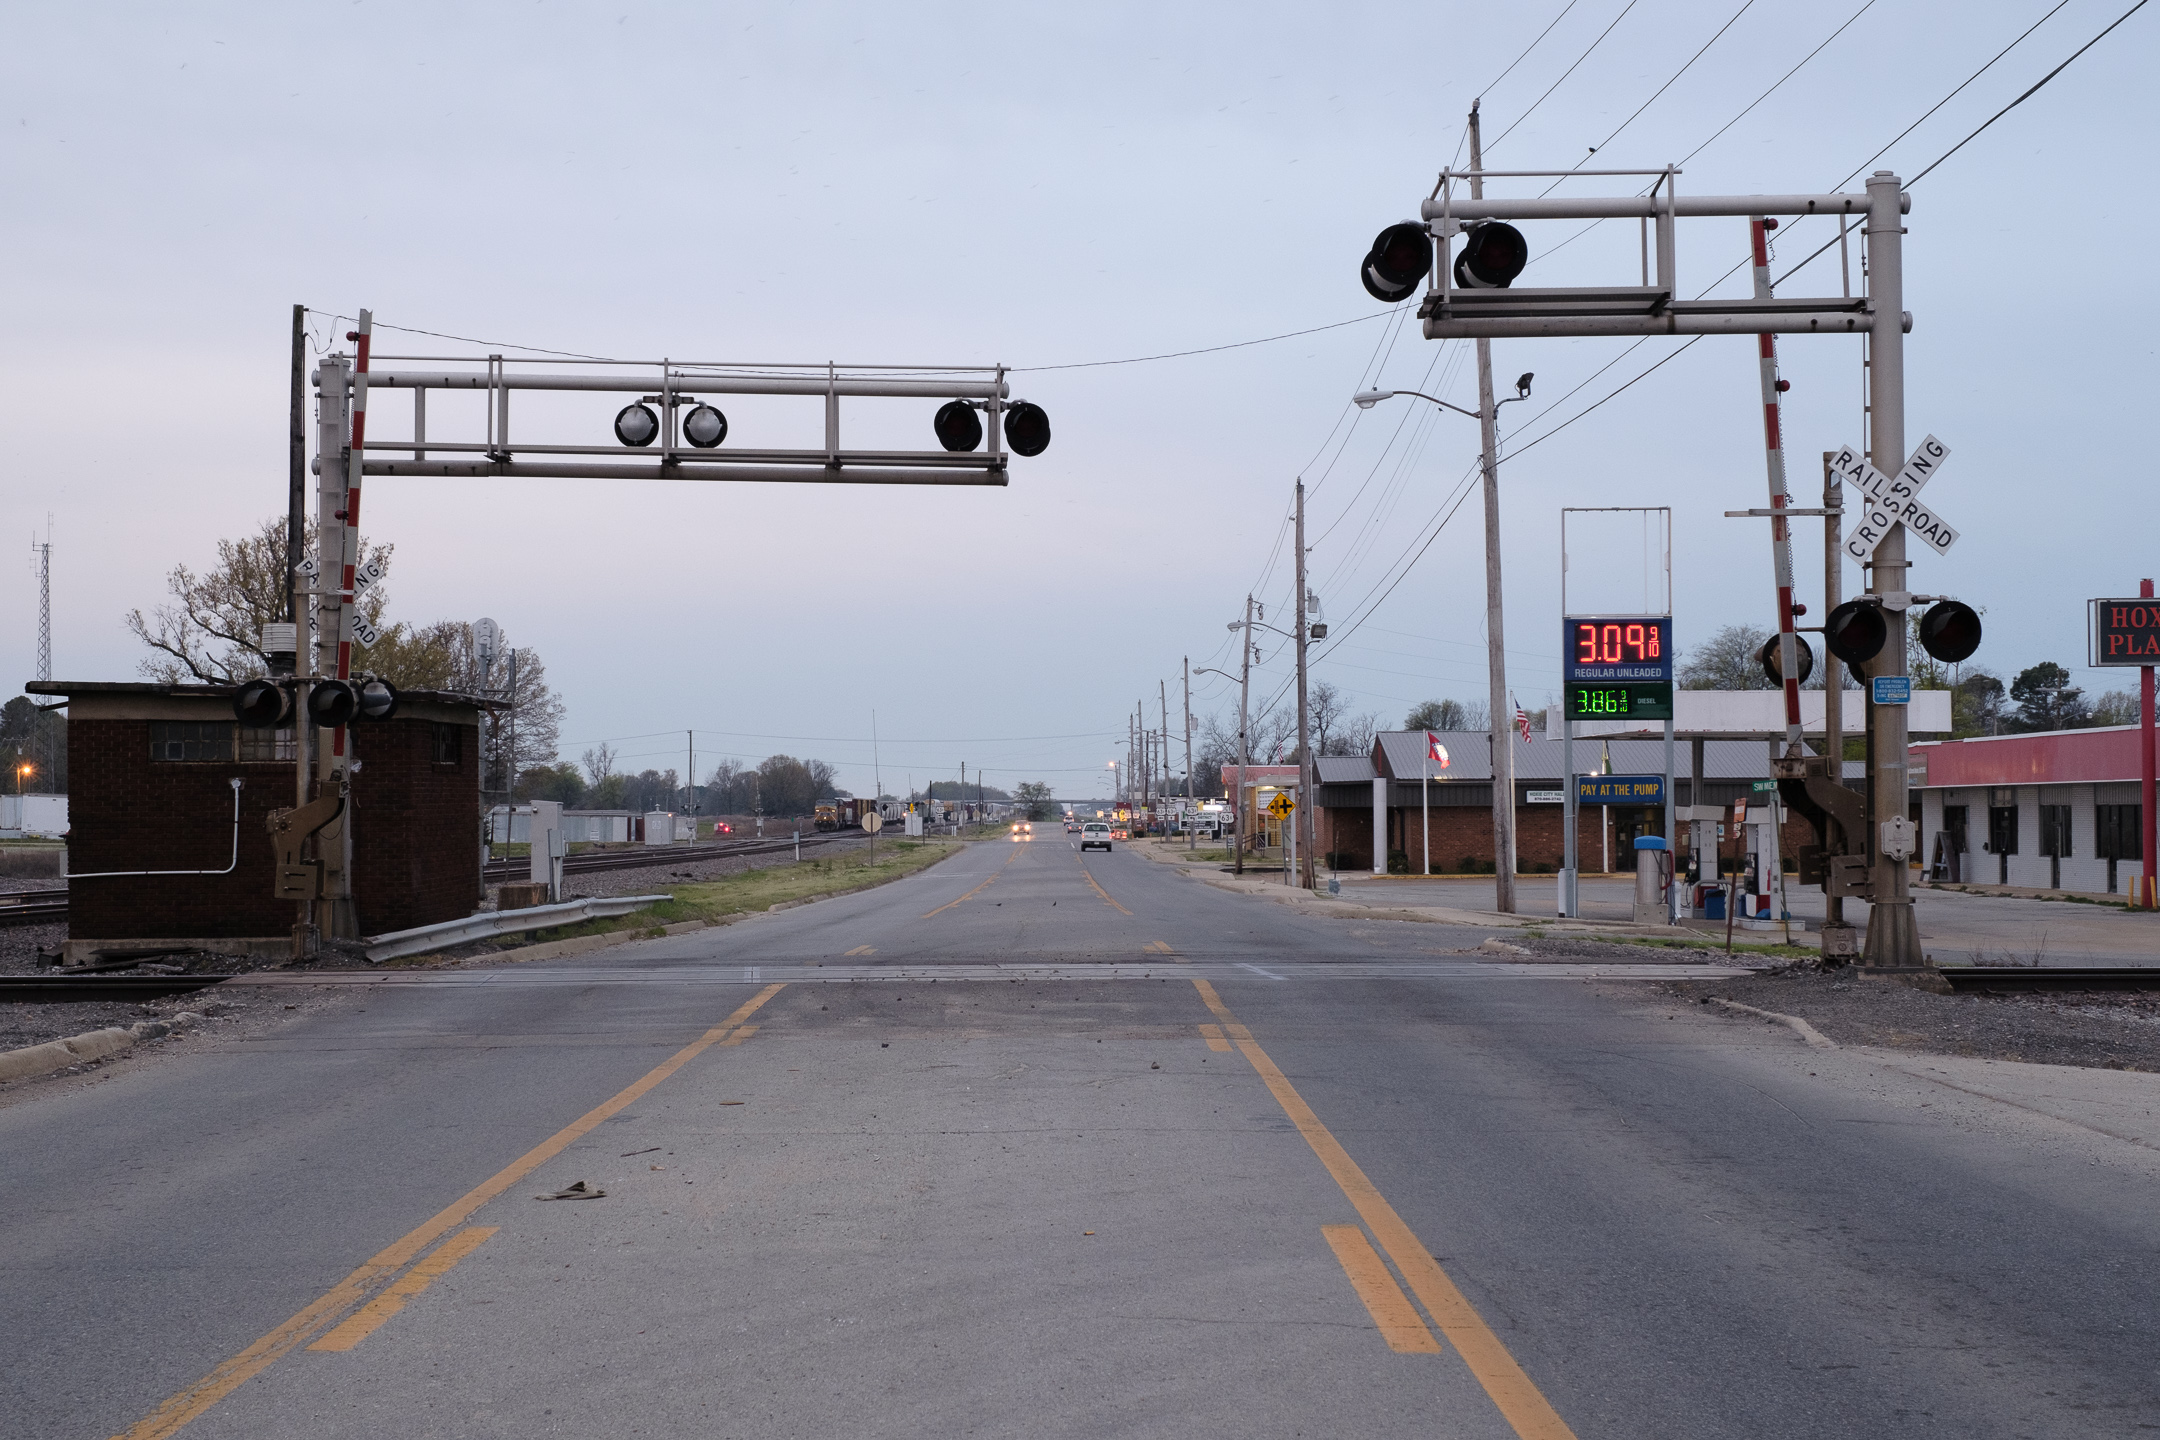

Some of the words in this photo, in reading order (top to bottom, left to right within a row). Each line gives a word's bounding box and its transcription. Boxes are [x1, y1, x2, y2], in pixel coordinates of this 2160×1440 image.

[1835, 450, 1884, 499] RAIL
[1901, 502, 1952, 548] ROAD
[1848, 441, 1944, 558] CROSSING
[352, 615, 376, 643] OAD
[1580, 624, 1645, 662] 3.09
[1574, 668, 1615, 678] REGULAR
[1616, 668, 1662, 677] UNLEADED
[1577, 690, 1617, 713] 3.86
[1580, 784, 1597, 796] PAY
[1600, 784, 1611, 796] AT
[1613, 784, 1630, 795] THE
[1634, 783, 1659, 795] PUMP
